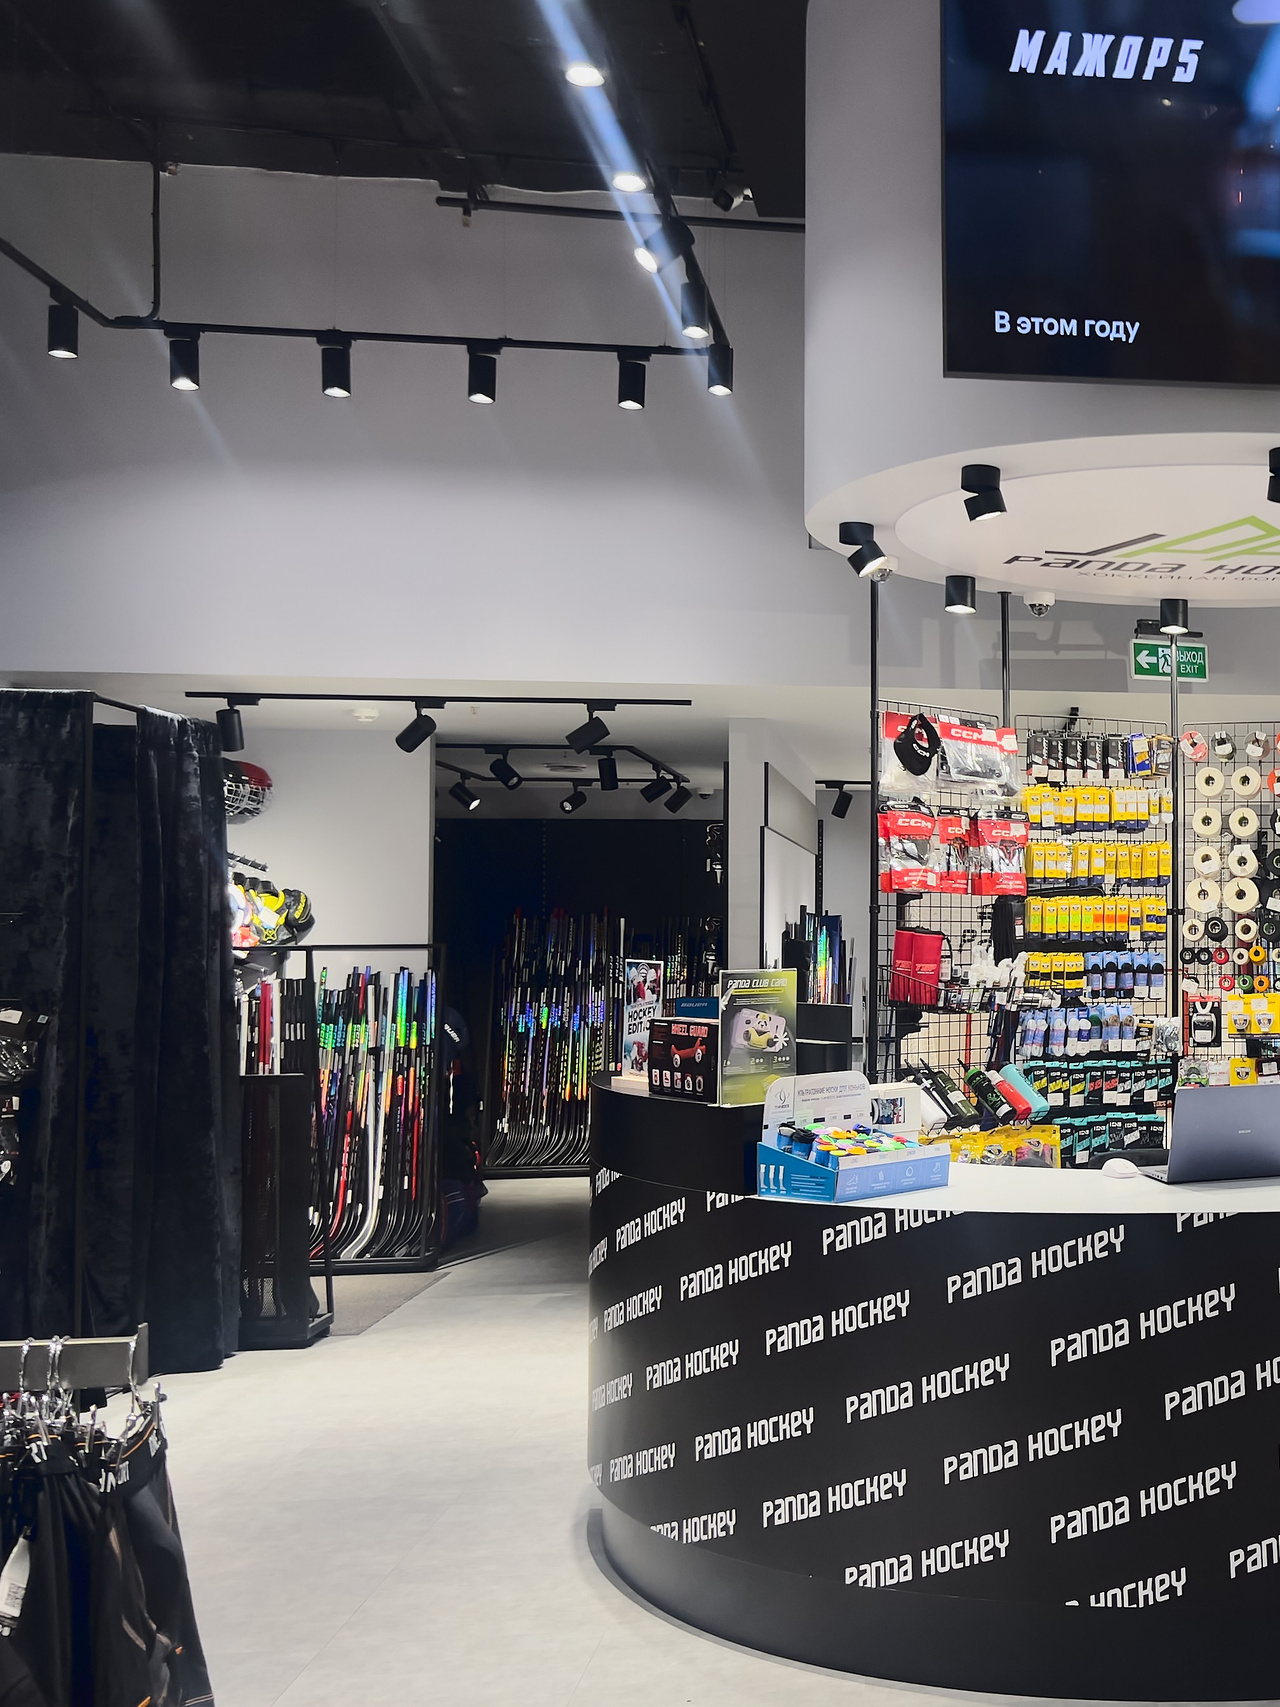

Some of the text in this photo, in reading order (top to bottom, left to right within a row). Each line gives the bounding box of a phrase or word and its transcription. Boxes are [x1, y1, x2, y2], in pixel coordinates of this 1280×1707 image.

[994, 310, 1140, 343] В этом году
[1180, 665, 1198, 673] EXIT
[898, 818, 932, 830] CCM
[751, 978, 769, 988] CLUB
[627, 1005, 657, 1023] HOCKEY
